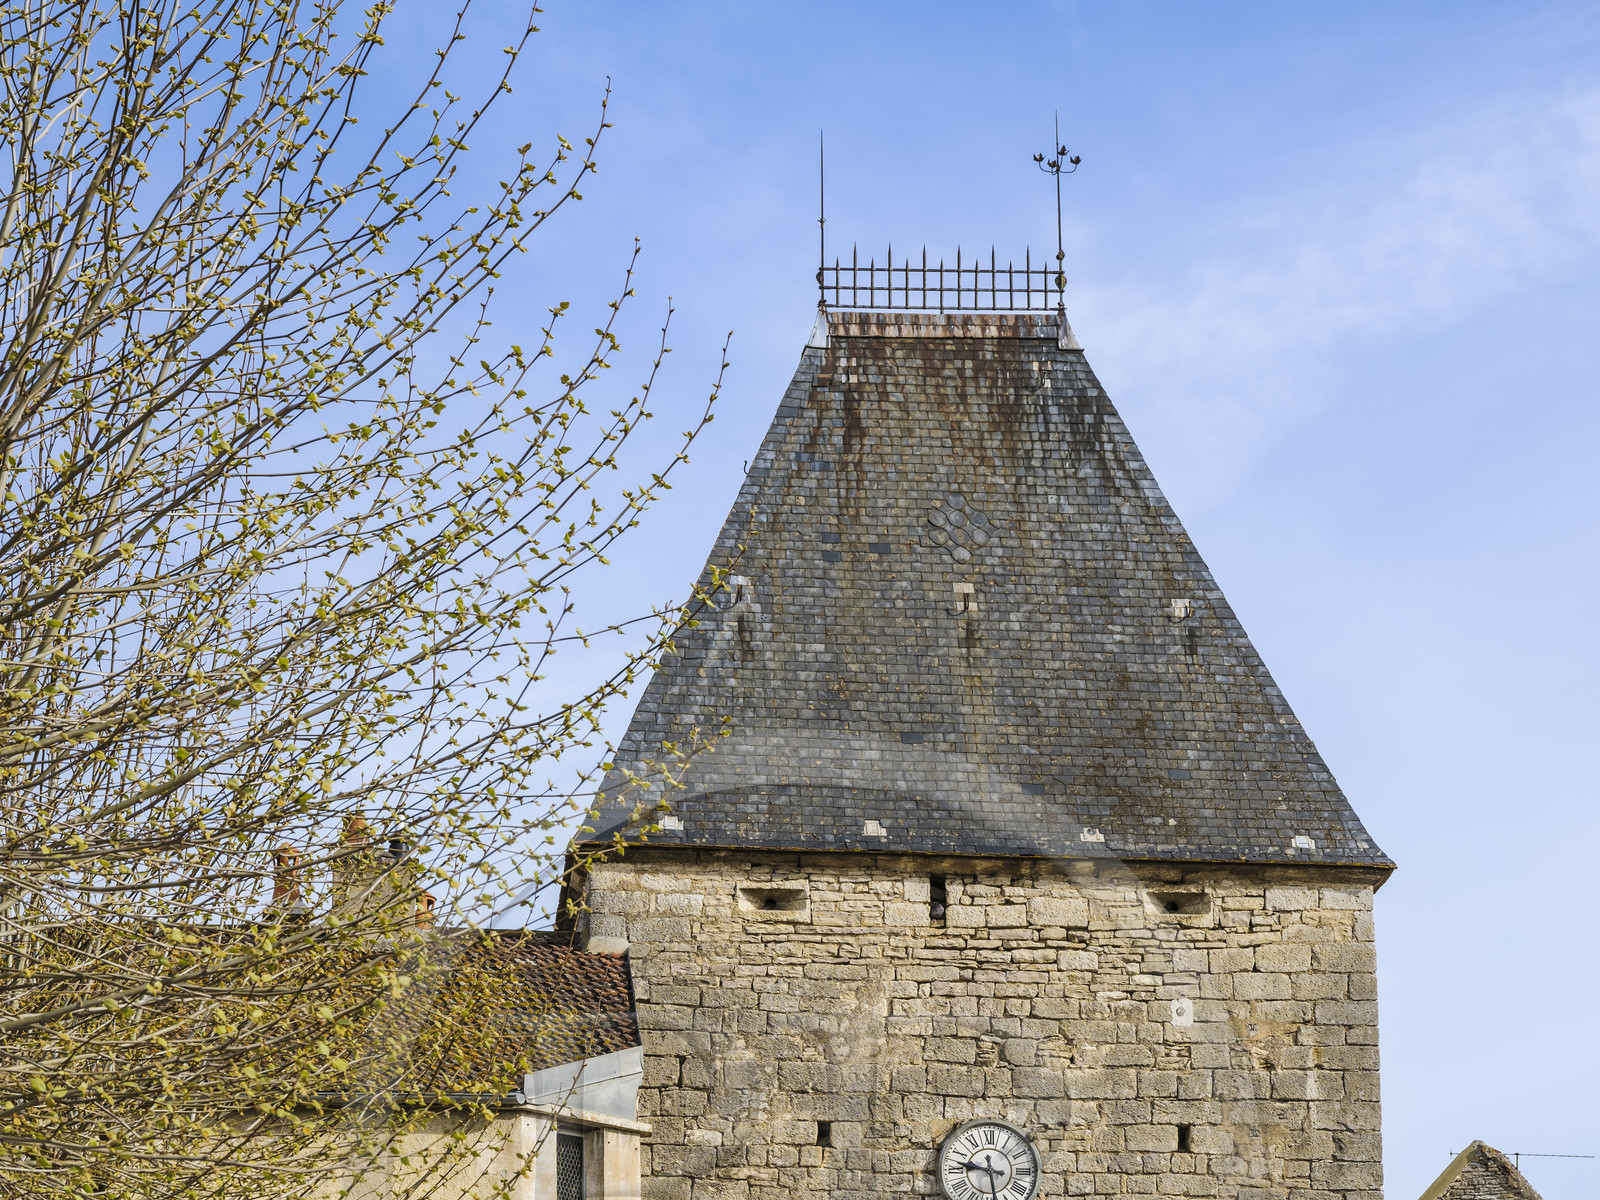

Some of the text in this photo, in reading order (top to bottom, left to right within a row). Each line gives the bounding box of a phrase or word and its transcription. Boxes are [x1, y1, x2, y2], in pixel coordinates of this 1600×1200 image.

[964, 1133, 980, 1150] XI
[983, 1130, 995, 1145] XII
[1001, 1136, 1011, 1149] I
[952, 1147, 968, 1160] X
[1012, 1149, 1027, 1160] II
[1015, 1167, 1031, 1176] III
[951, 1179, 970, 1197] VIII
[1009, 1180, 1028, 1197] IIII
